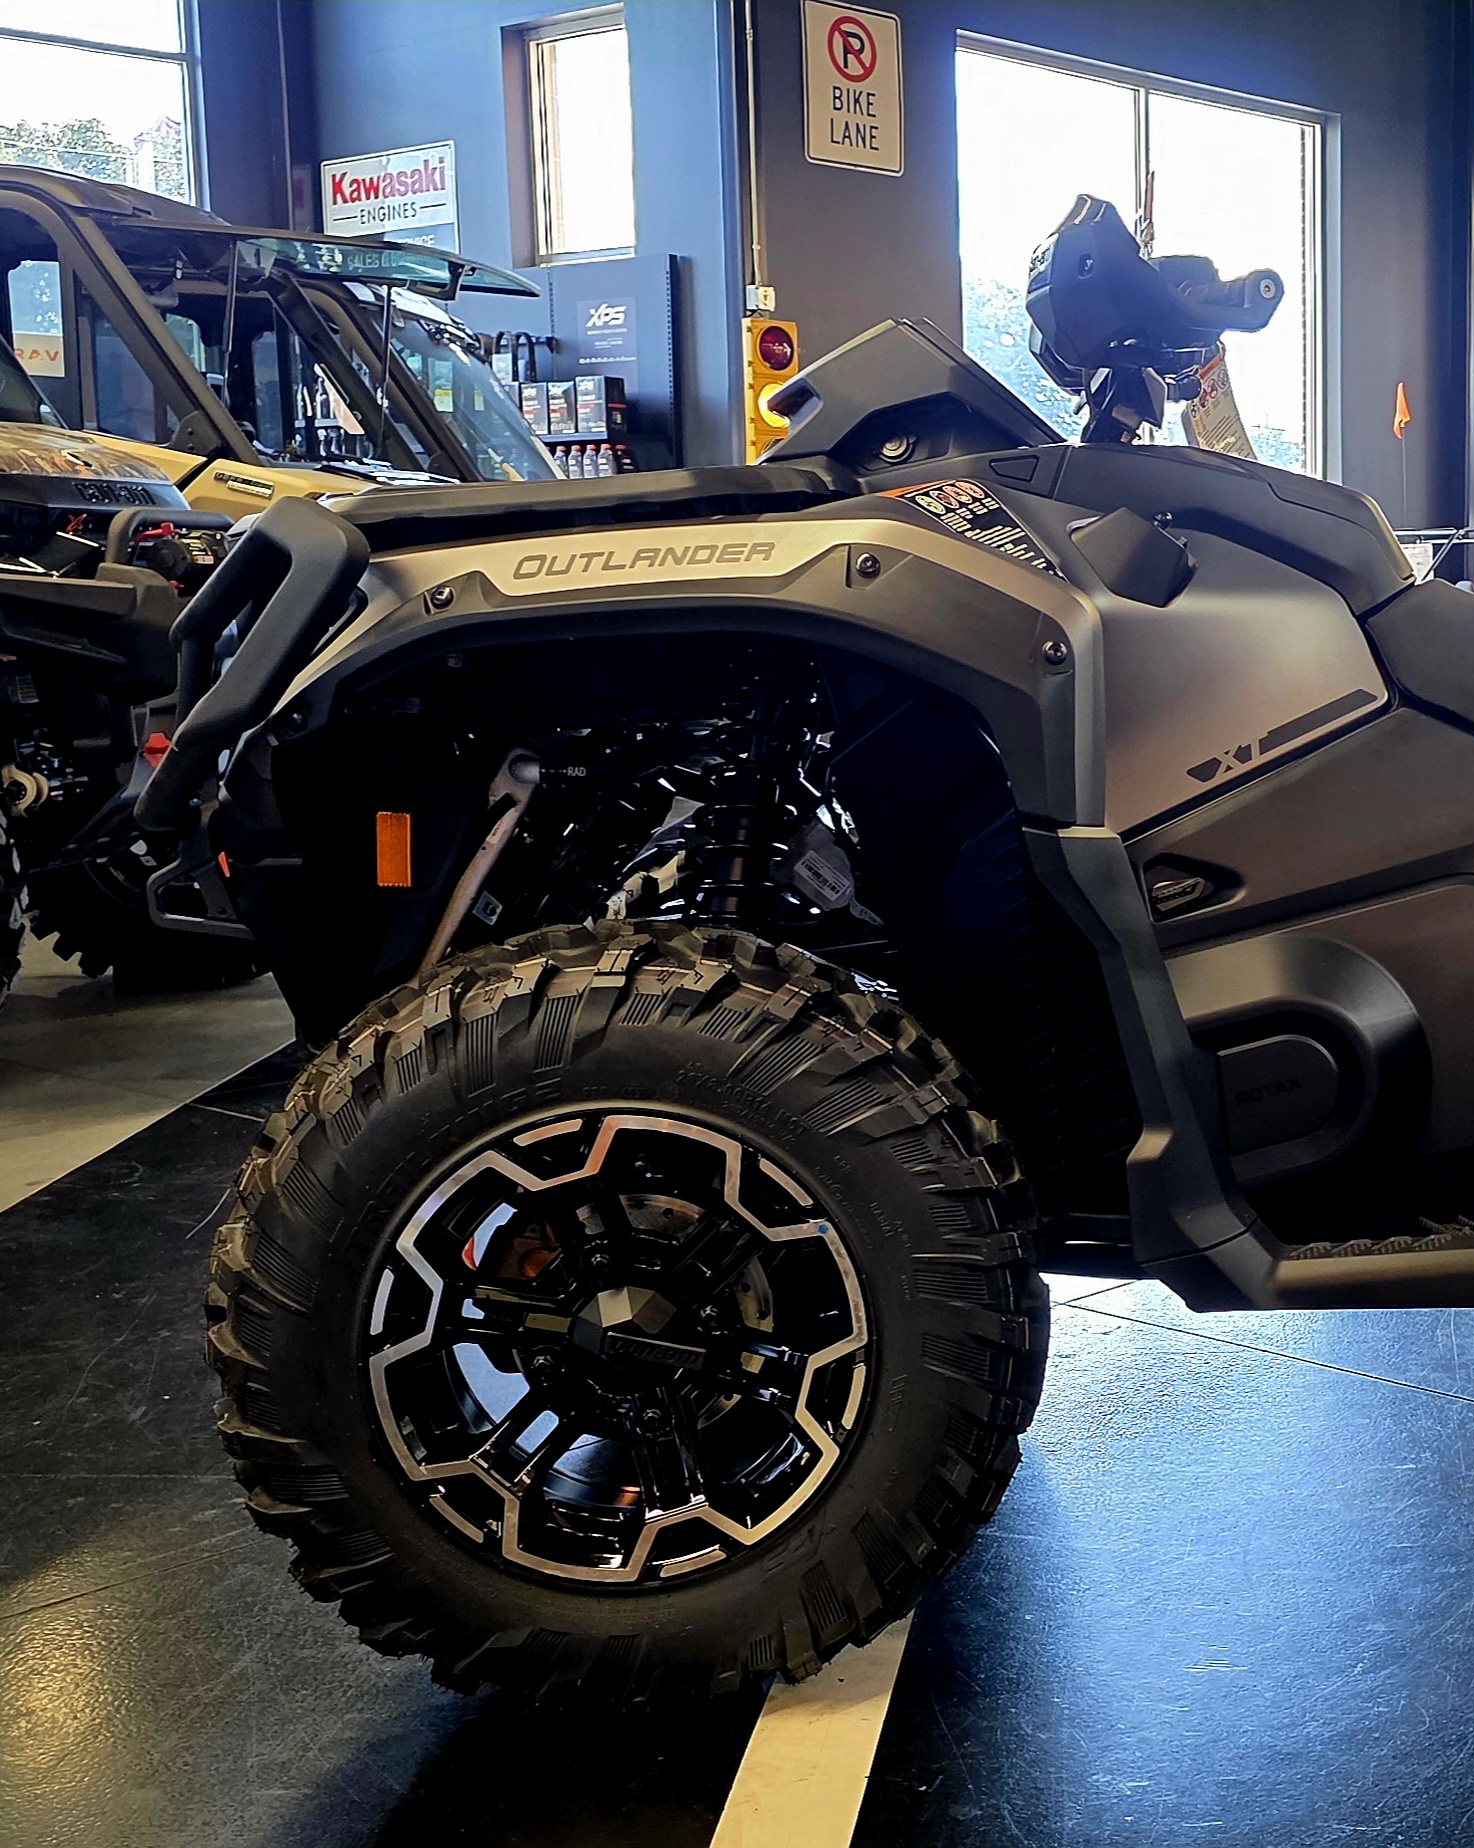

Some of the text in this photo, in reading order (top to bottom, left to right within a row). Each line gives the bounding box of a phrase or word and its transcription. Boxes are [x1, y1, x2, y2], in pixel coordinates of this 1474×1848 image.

[832, 85, 876, 118] BIKE
[830, 118, 879, 151] LANE
[332, 157, 446, 205] Kawasaki
[360, 202, 417, 224] ENGINES
[586, 303, 627, 327] XPS
[513, 542, 776, 580] OUTLANDER
[566, 765, 588, 777] RAD
